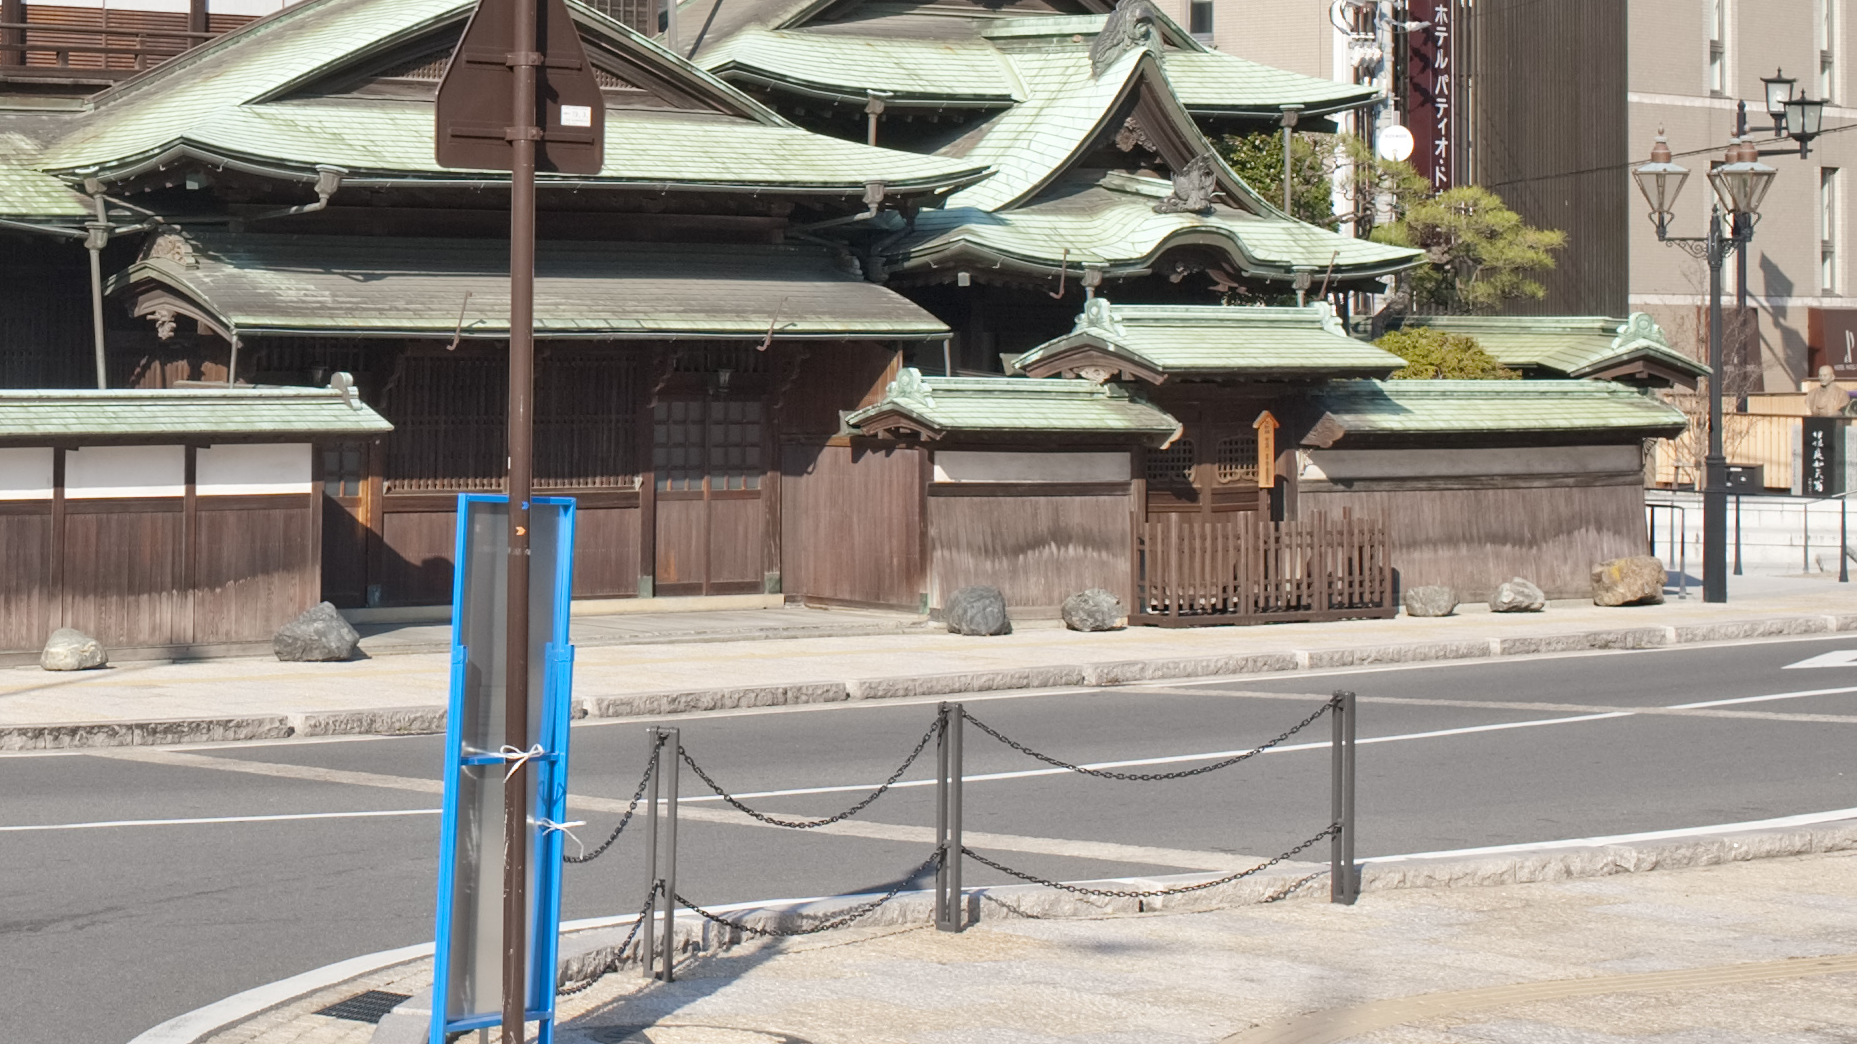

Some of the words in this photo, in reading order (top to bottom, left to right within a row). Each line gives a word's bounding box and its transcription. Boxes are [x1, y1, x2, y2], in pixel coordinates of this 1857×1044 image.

[1434, 4, 1449, 200] ホテルパティオ・ド
